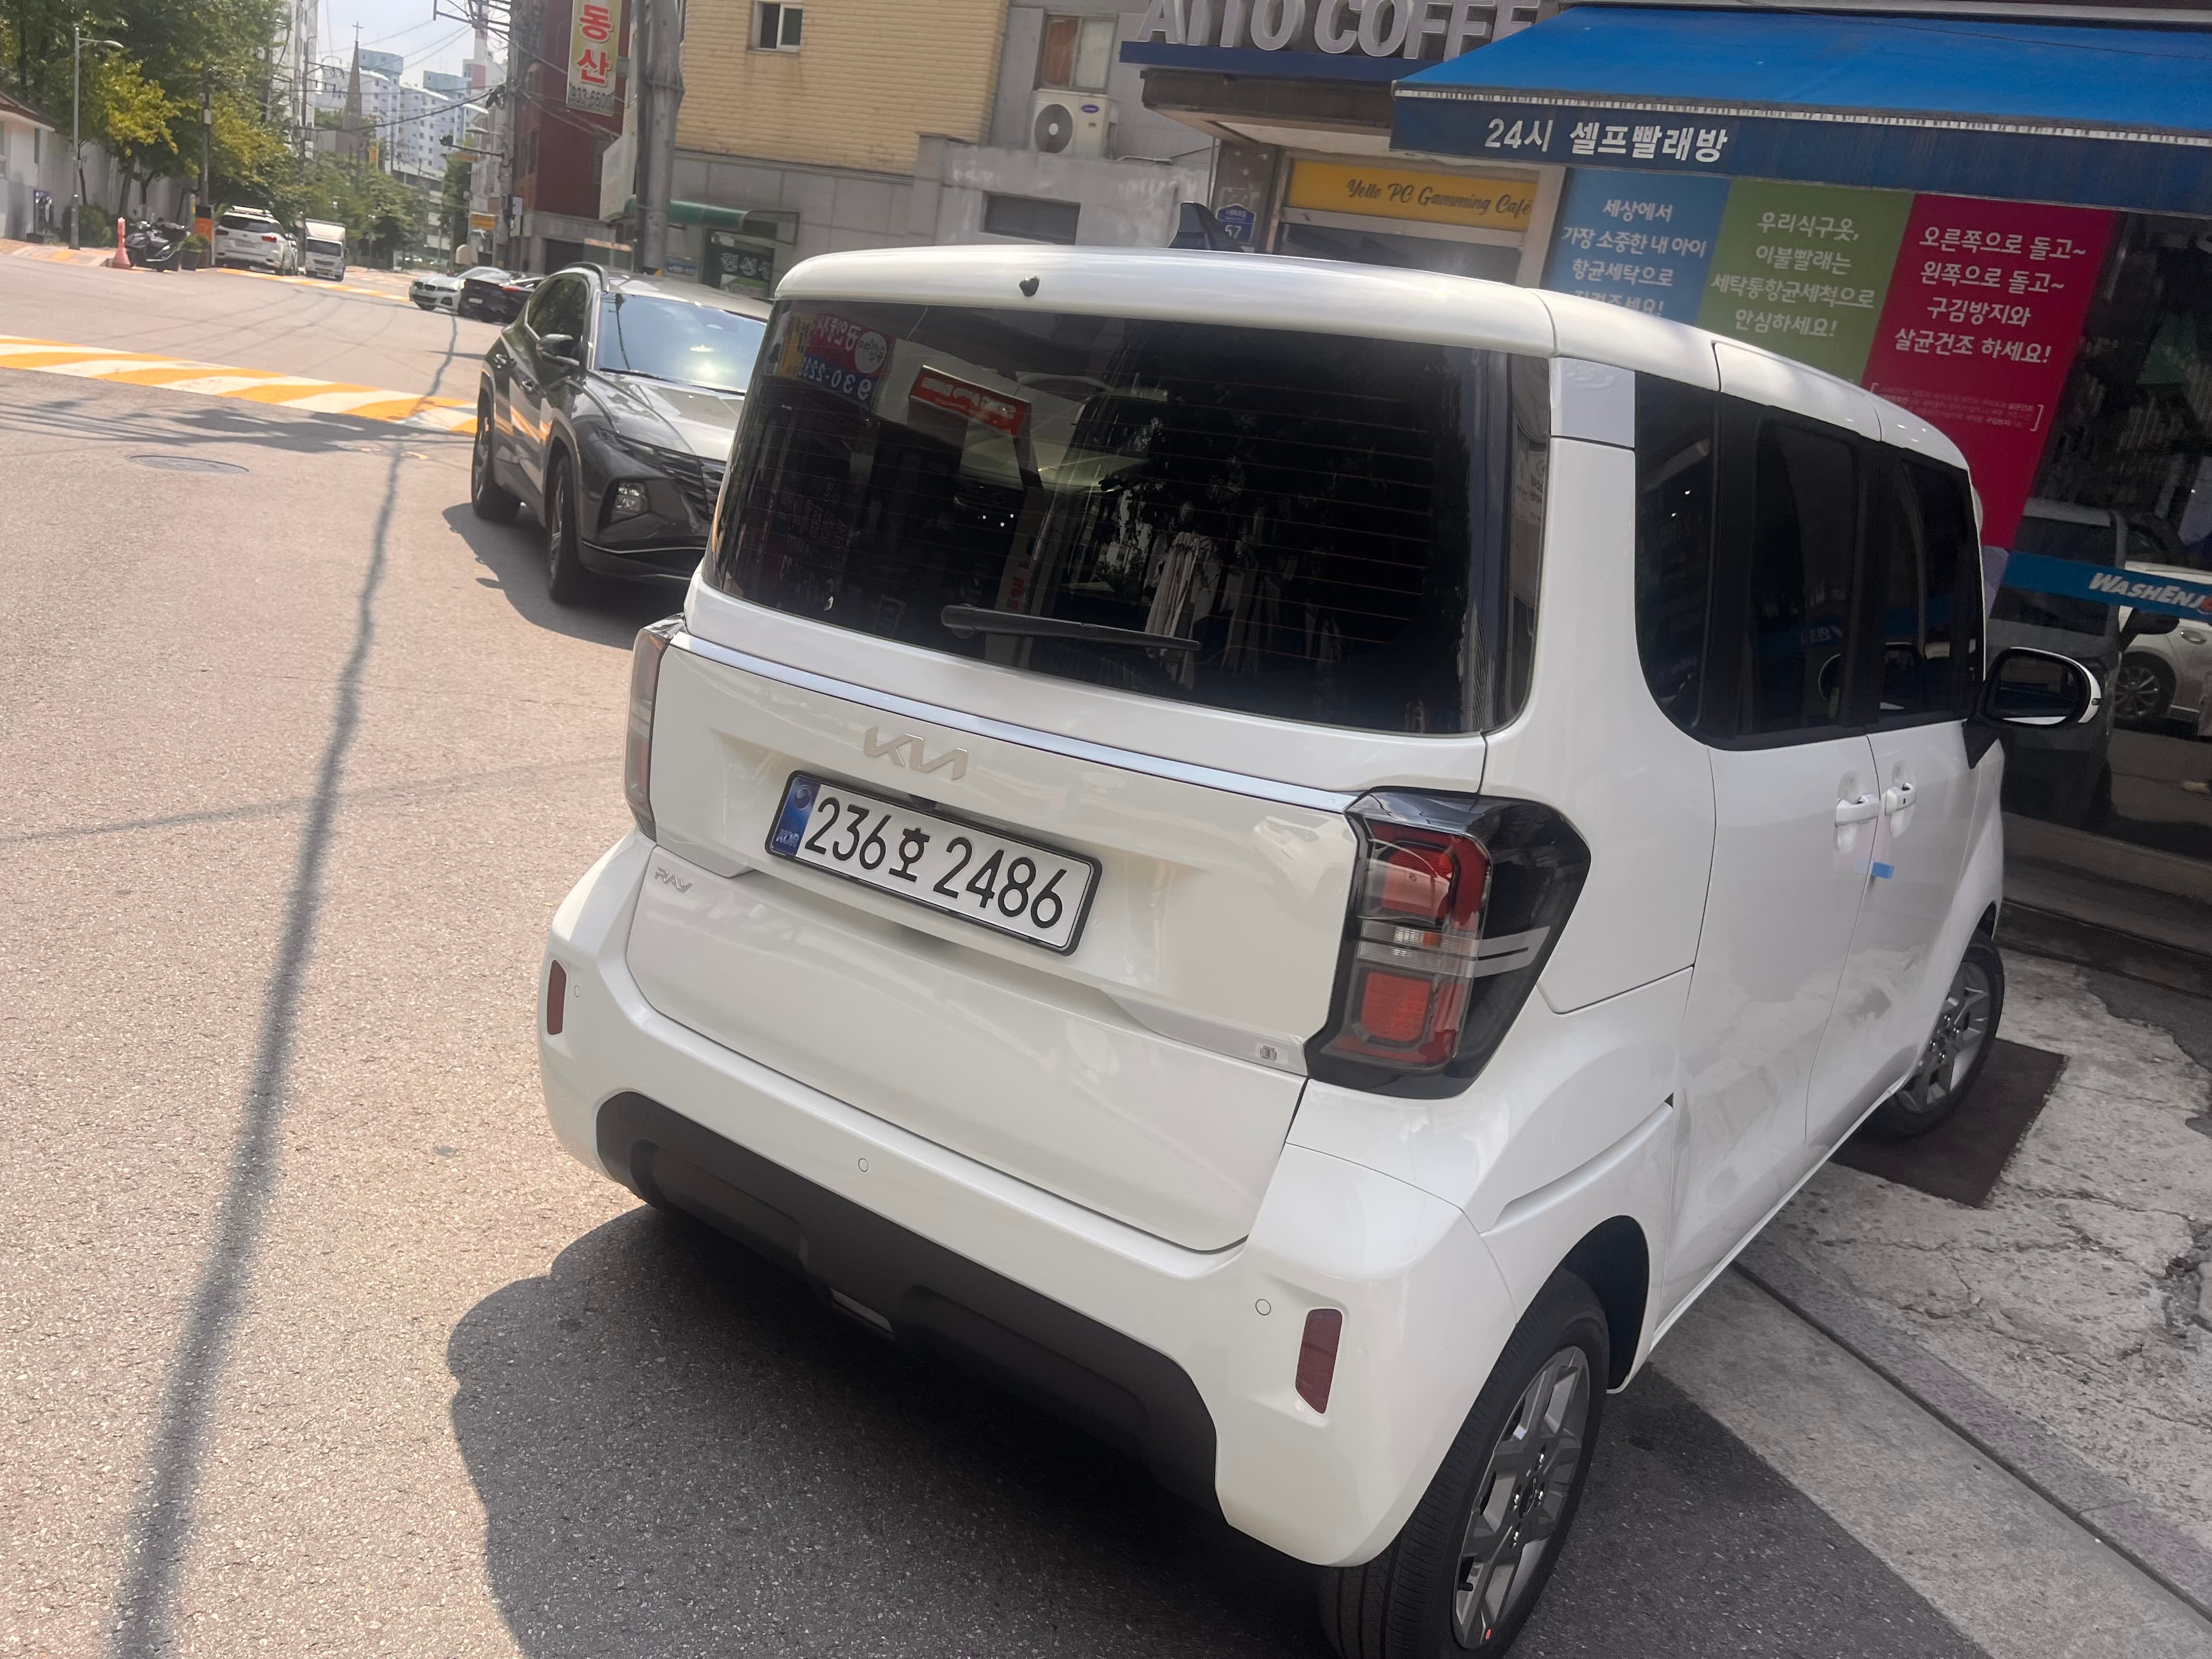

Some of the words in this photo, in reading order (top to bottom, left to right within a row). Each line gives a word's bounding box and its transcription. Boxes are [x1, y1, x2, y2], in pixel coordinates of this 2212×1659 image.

[1484, 118, 1554, 152] 24시
[1569, 121, 1728, 163] 셀프빨래방
[1387, 183, 1415, 203] PC
[1603, 198, 1673, 223] 세상에서
[1757, 211, 1859, 241] 우리식구옷,
[1560, 226, 1595, 249] 가장
[1596, 232, 1647, 255] 소중한
[1650, 236, 1667, 255] 내
[1672, 237, 1707, 259] 아이
[1919, 226, 2022, 255] 오른쪽으로
[2029, 236, 2086, 260] 돌고~
[1572, 257, 1674, 287] 항균세탁으로
[1755, 244, 1852, 275] 이불빨래는
[1711, 272, 1875, 309] 세탁통항균세척으로
[1920, 260, 2001, 289] 왼쪽으로
[2009, 270, 2064, 294] 돌고~
[1735, 309, 1838, 338] 안심하세요!
[1926, 297, 2031, 327] 구김방지와
[1894, 327, 1975, 356] 살균건조
[1980, 337, 2052, 364] 하세요!
[864, 724, 968, 781] KIA
[775, 828, 800, 848] KOR
[805, 797, 930, 883] 236호
[933, 837, 1067, 929] 2486
[654, 866, 693, 893] RAY
